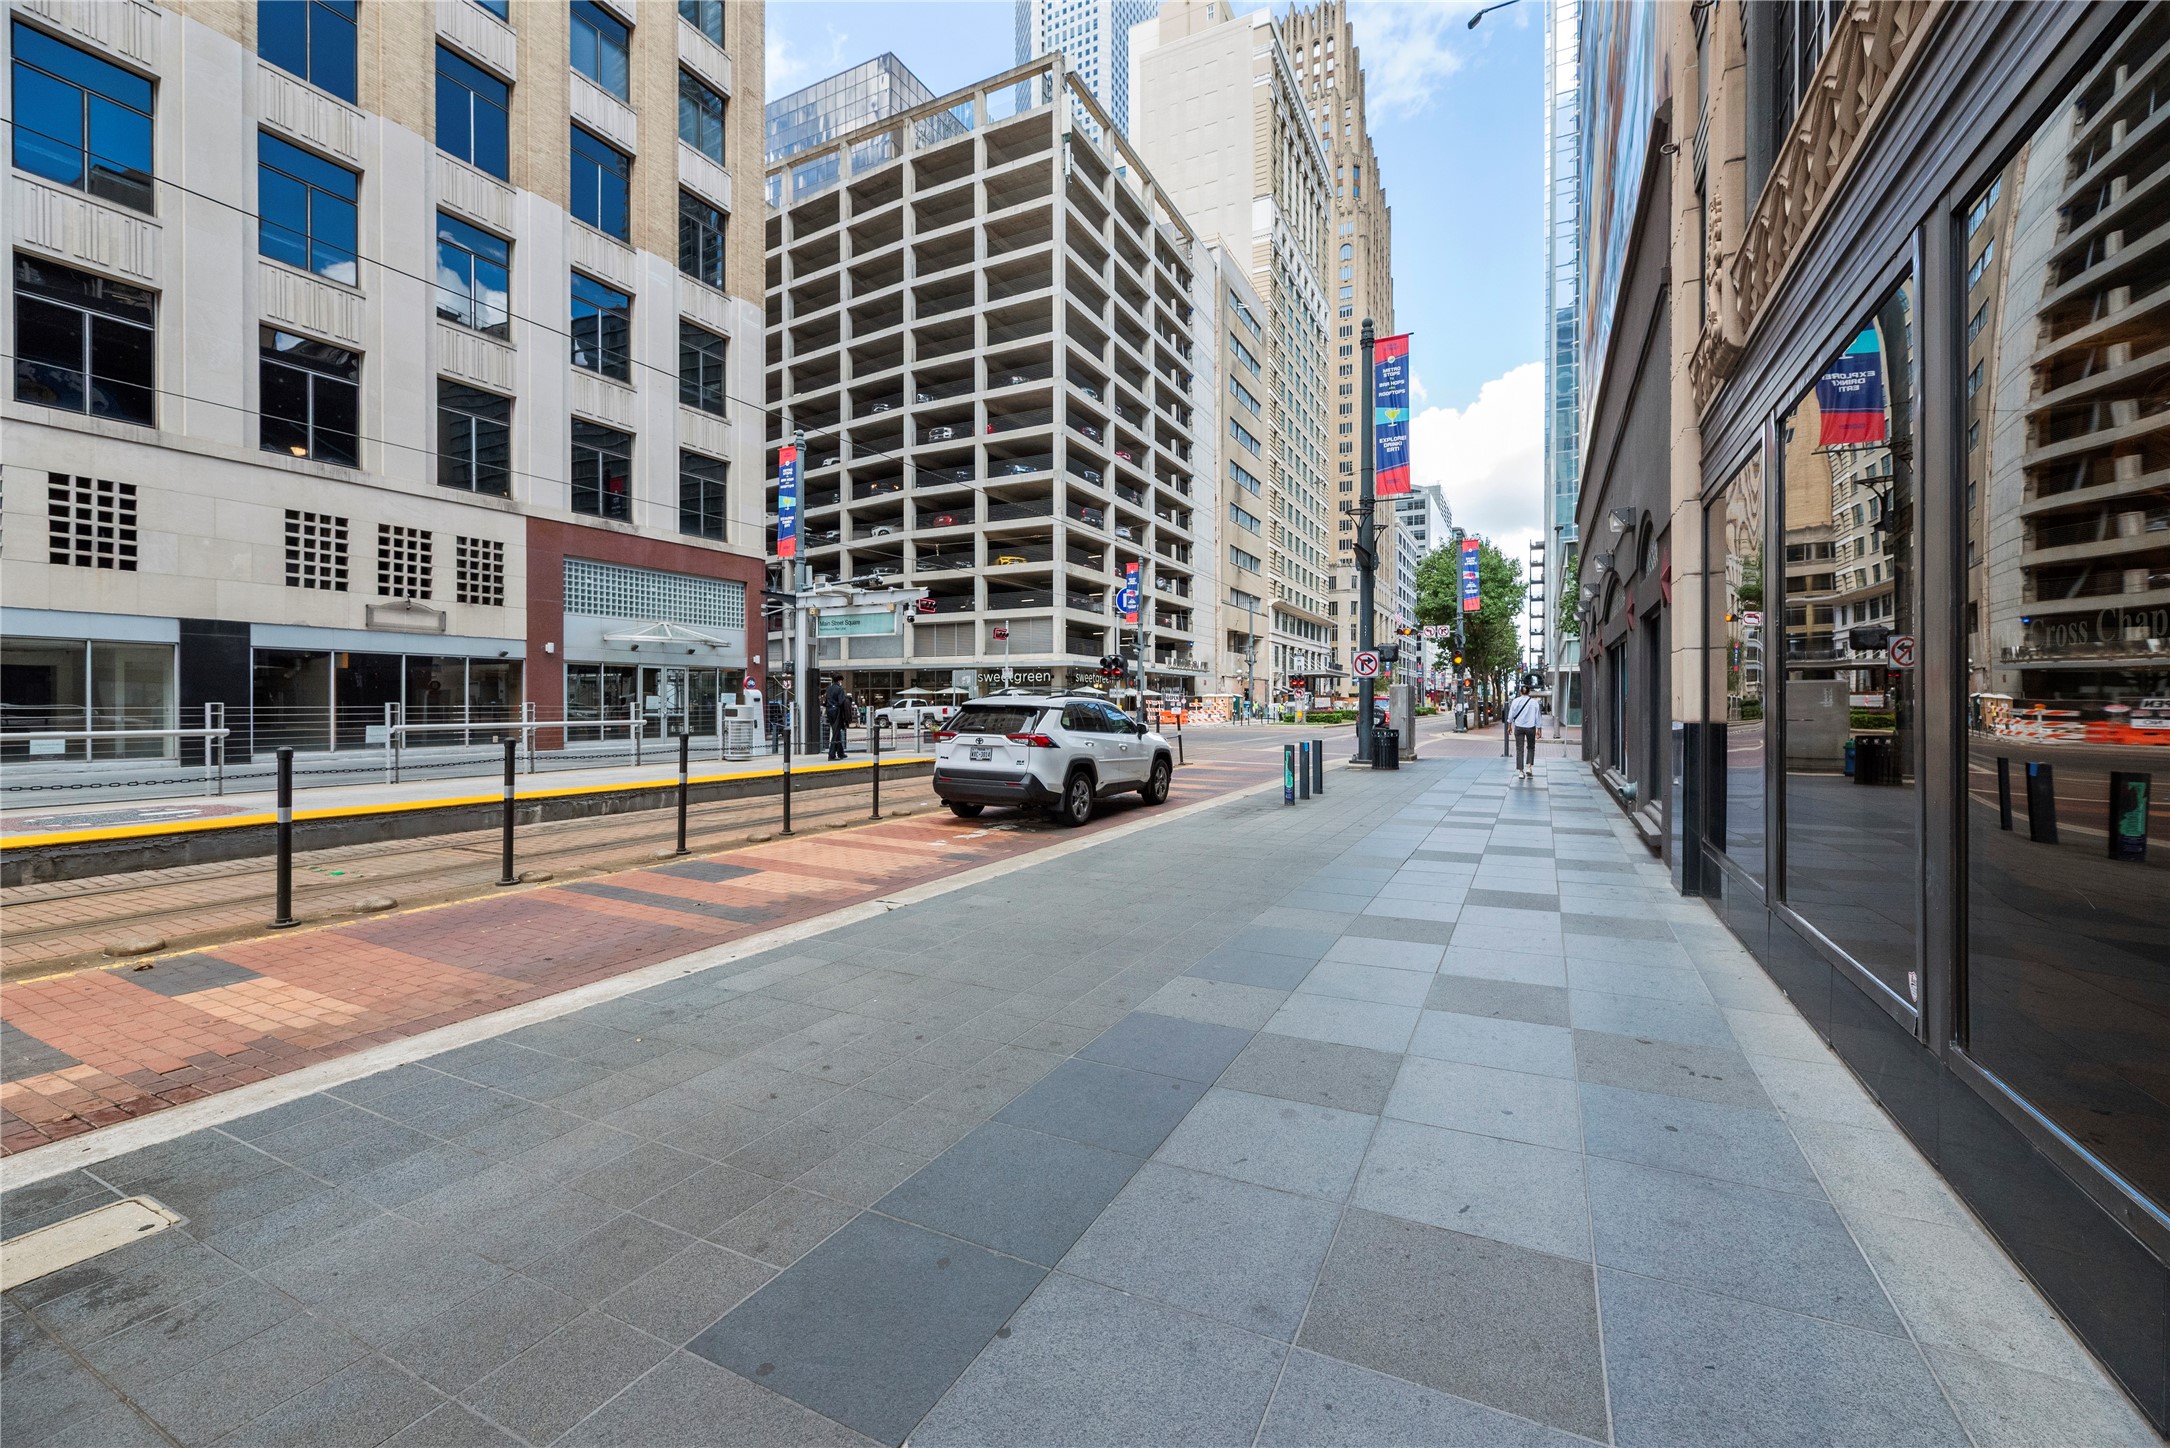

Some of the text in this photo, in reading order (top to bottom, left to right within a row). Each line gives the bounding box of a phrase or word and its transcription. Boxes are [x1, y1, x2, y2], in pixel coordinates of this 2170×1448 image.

[1379, 389, 1405, 397] ROOFTOPS
[844, 619, 861, 627] Square
[2029, 618, 2089, 649] Cross
